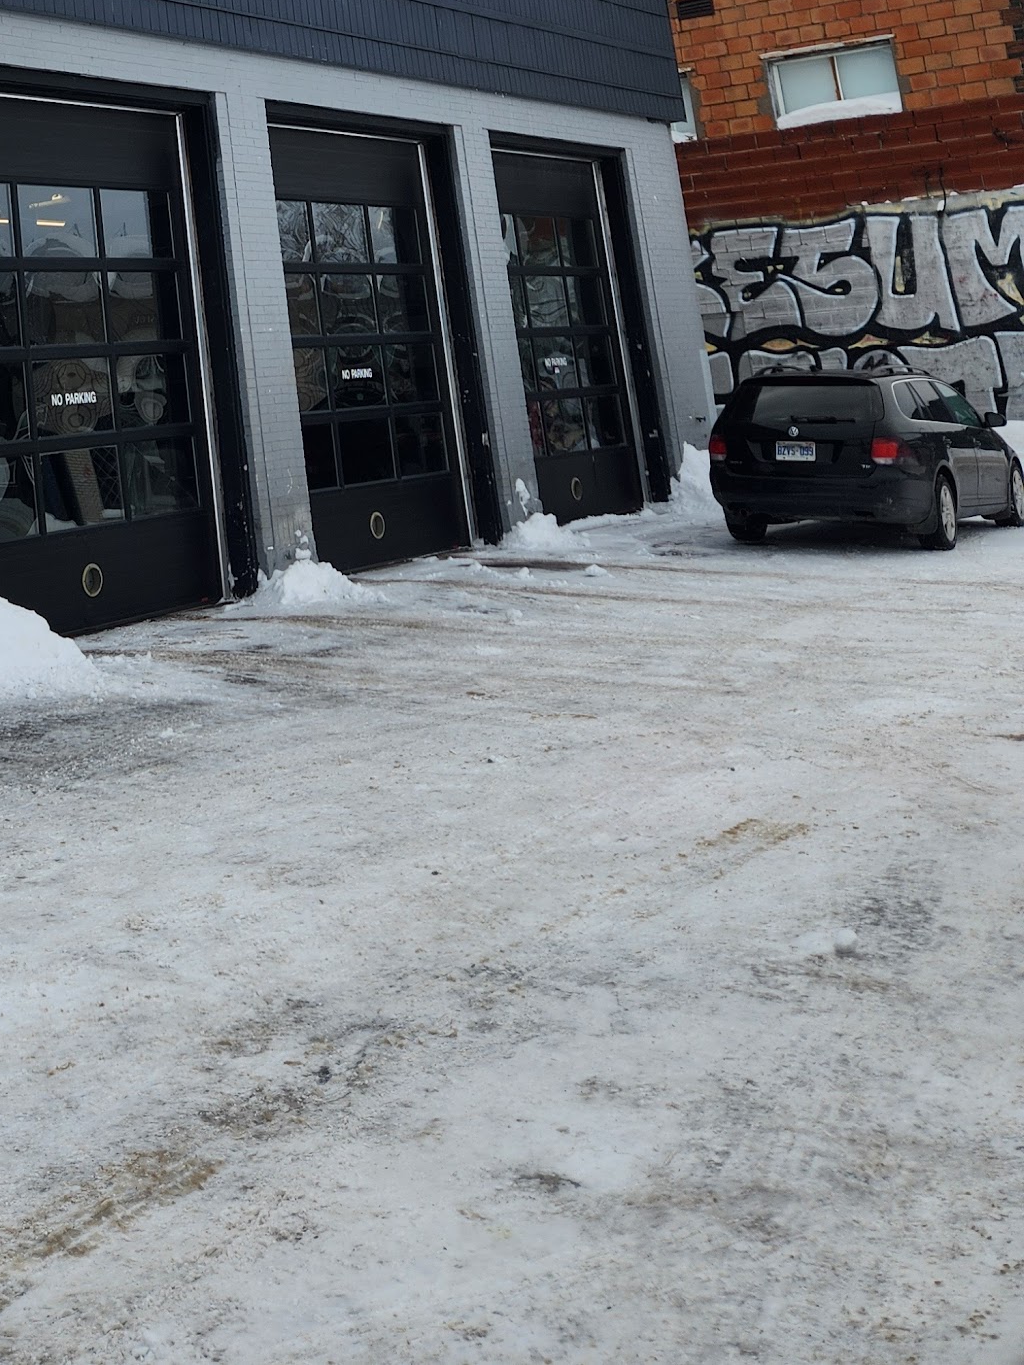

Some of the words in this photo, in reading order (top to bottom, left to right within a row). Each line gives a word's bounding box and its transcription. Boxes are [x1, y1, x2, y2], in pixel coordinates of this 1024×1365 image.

[341, 369, 351, 380] NO
[351, 367, 373, 380] PARKING
[51, 394, 63, 406] NO
[65, 391, 97, 405] PARKING
